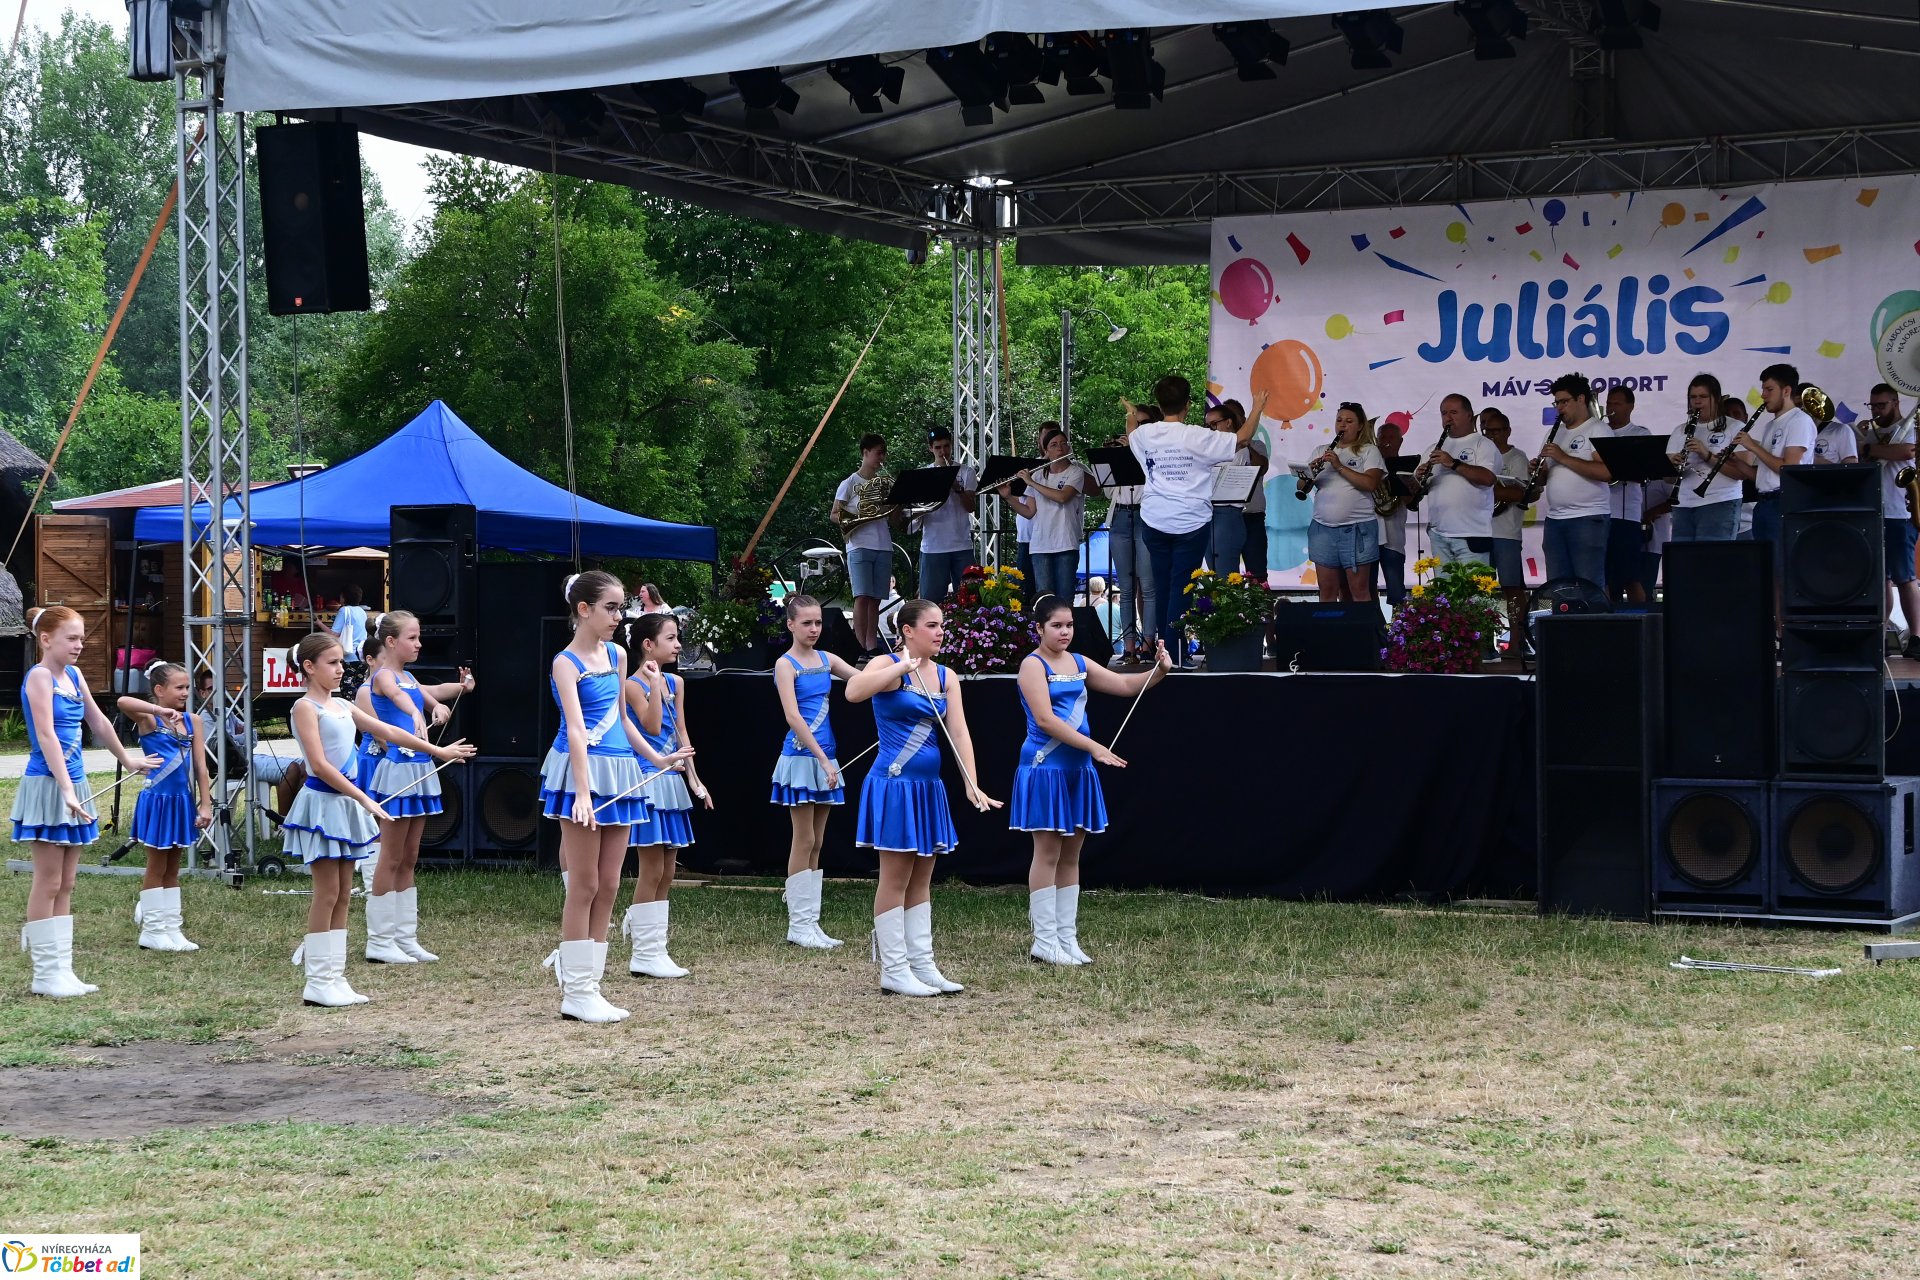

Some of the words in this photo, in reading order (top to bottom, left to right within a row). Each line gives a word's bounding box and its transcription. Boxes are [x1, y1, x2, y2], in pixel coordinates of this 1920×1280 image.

[1417, 274, 1730, 363] Juliális
[1886, 318, 1916, 352] SZABOLCSI
[1482, 376, 1531, 397] MÁV
